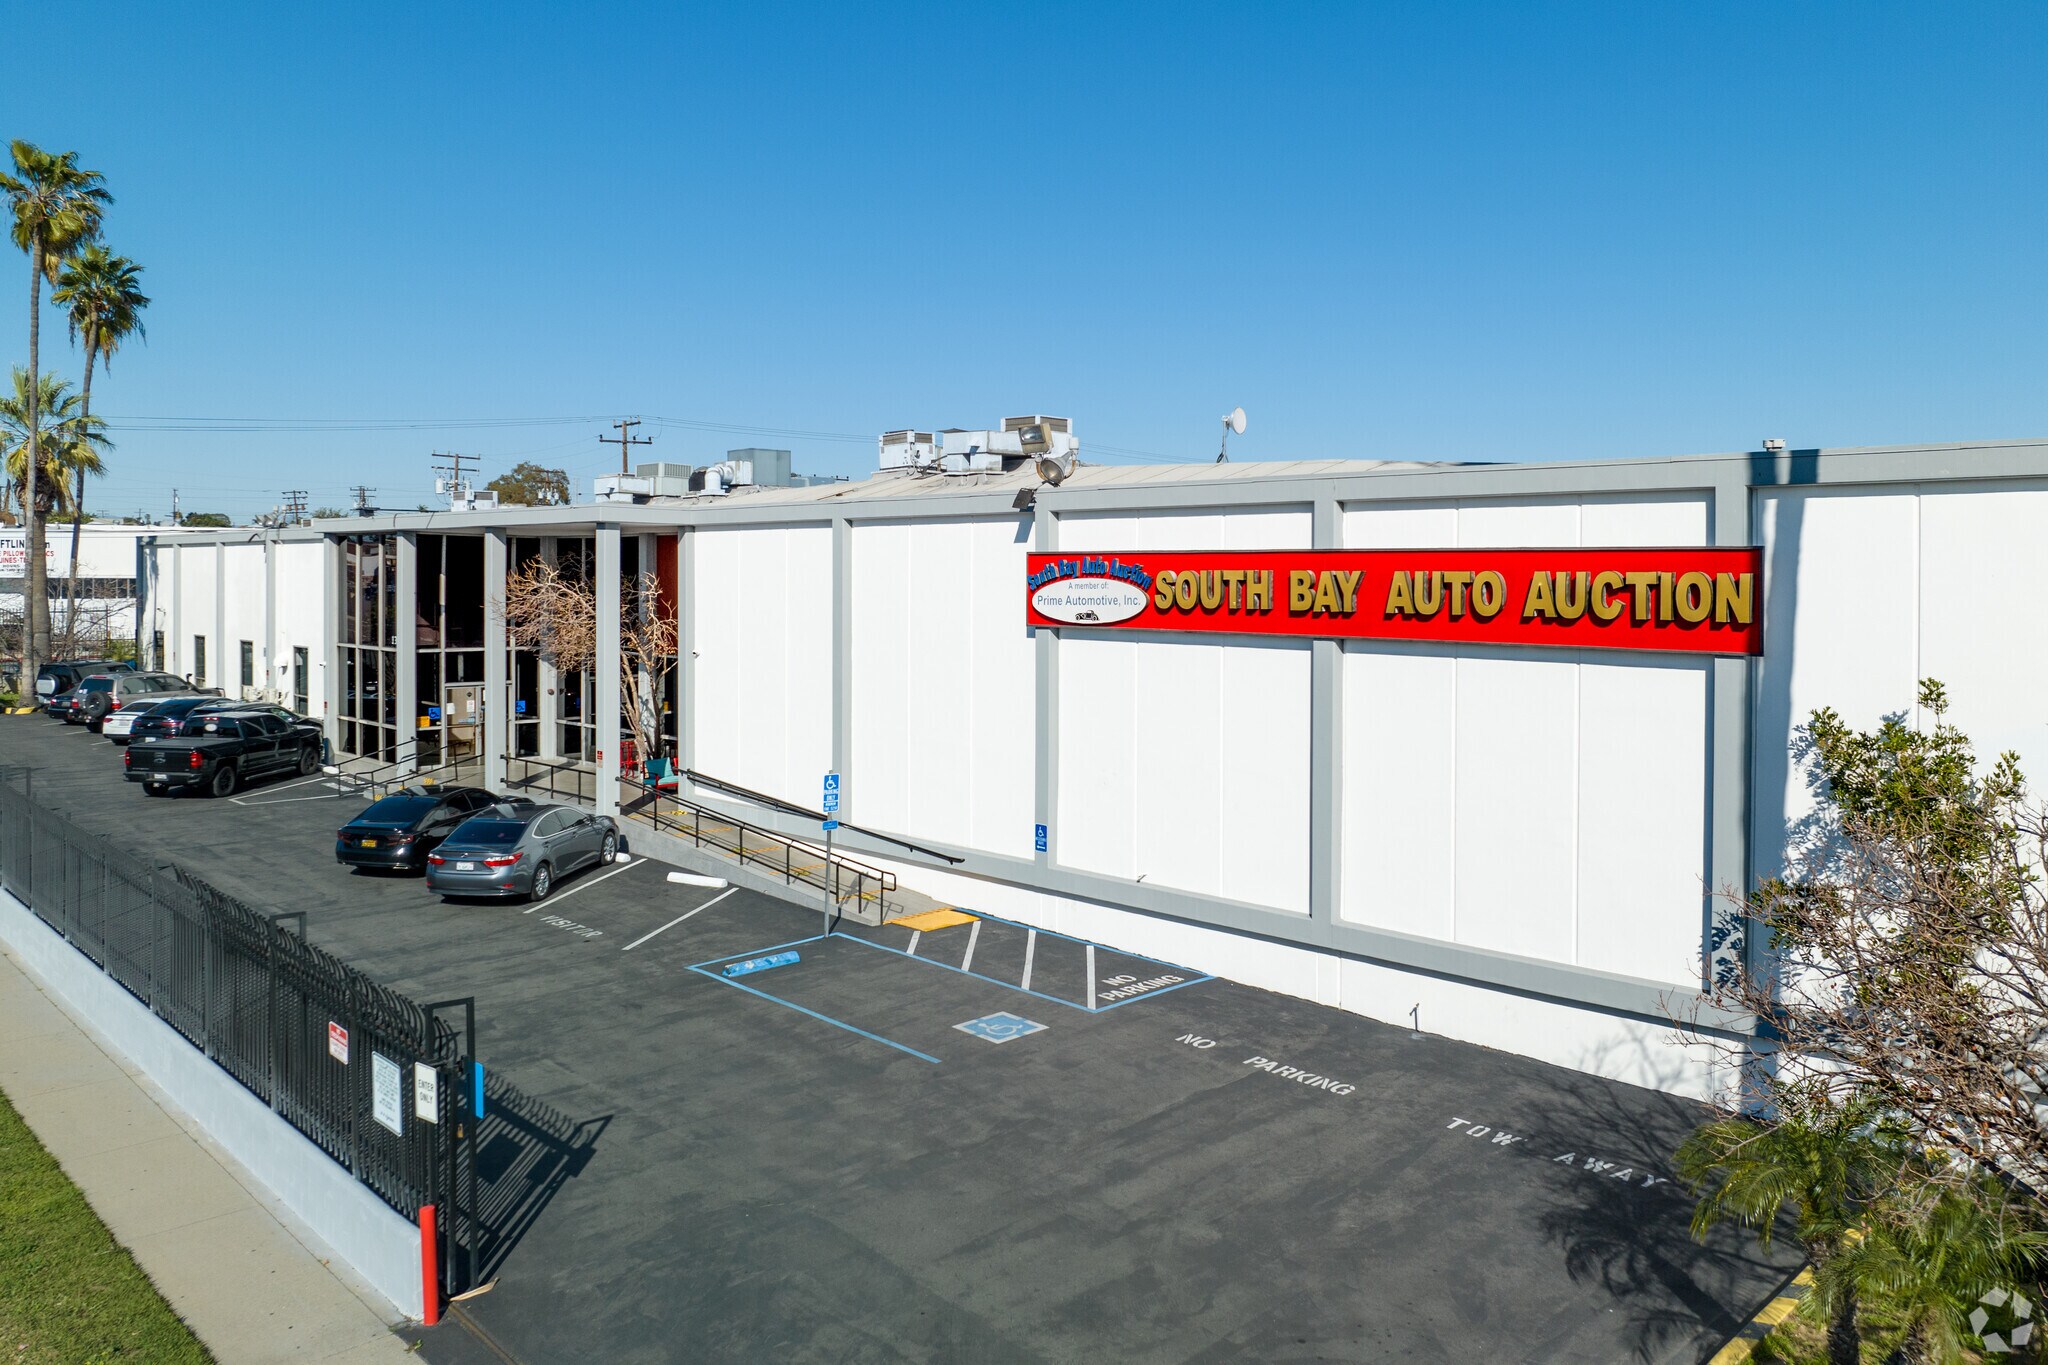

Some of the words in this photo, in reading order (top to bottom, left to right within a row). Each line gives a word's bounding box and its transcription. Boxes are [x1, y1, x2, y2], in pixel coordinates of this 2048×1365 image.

[1027, 562, 1059, 591] South
[1058, 559, 1080, 579] Bay
[1082, 555, 1109, 574] Auto
[1109, 557, 1153, 590] Auction
[1068, 582, 1073, 590] A
[1074, 582, 1099, 590] member
[1154, 569, 1273, 611] SOUTH
[1289, 569, 1366, 613] BAY
[1385, 570, 1507, 617] AUTO
[1523, 570, 1753, 624] AUCTION
[1037, 595, 1063, 606] Prime
[1065, 595, 1121, 607] Automotive,
[1123, 594, 1141, 606] Inc.
[540, 914, 603, 937] VISITOR
[1098, 974, 1185, 1001] PARKING
[1102, 974, 1137, 986] NO
[1175, 1033, 1217, 1049] NO
[1242, 1055, 1356, 1097] PARKING
[418, 1079, 434, 1092] ENTER
[420, 1091, 433, 1104] ONLY
[1446, 1117, 1523, 1146] TOW
[1553, 1152, 1671, 1188] AWAY
